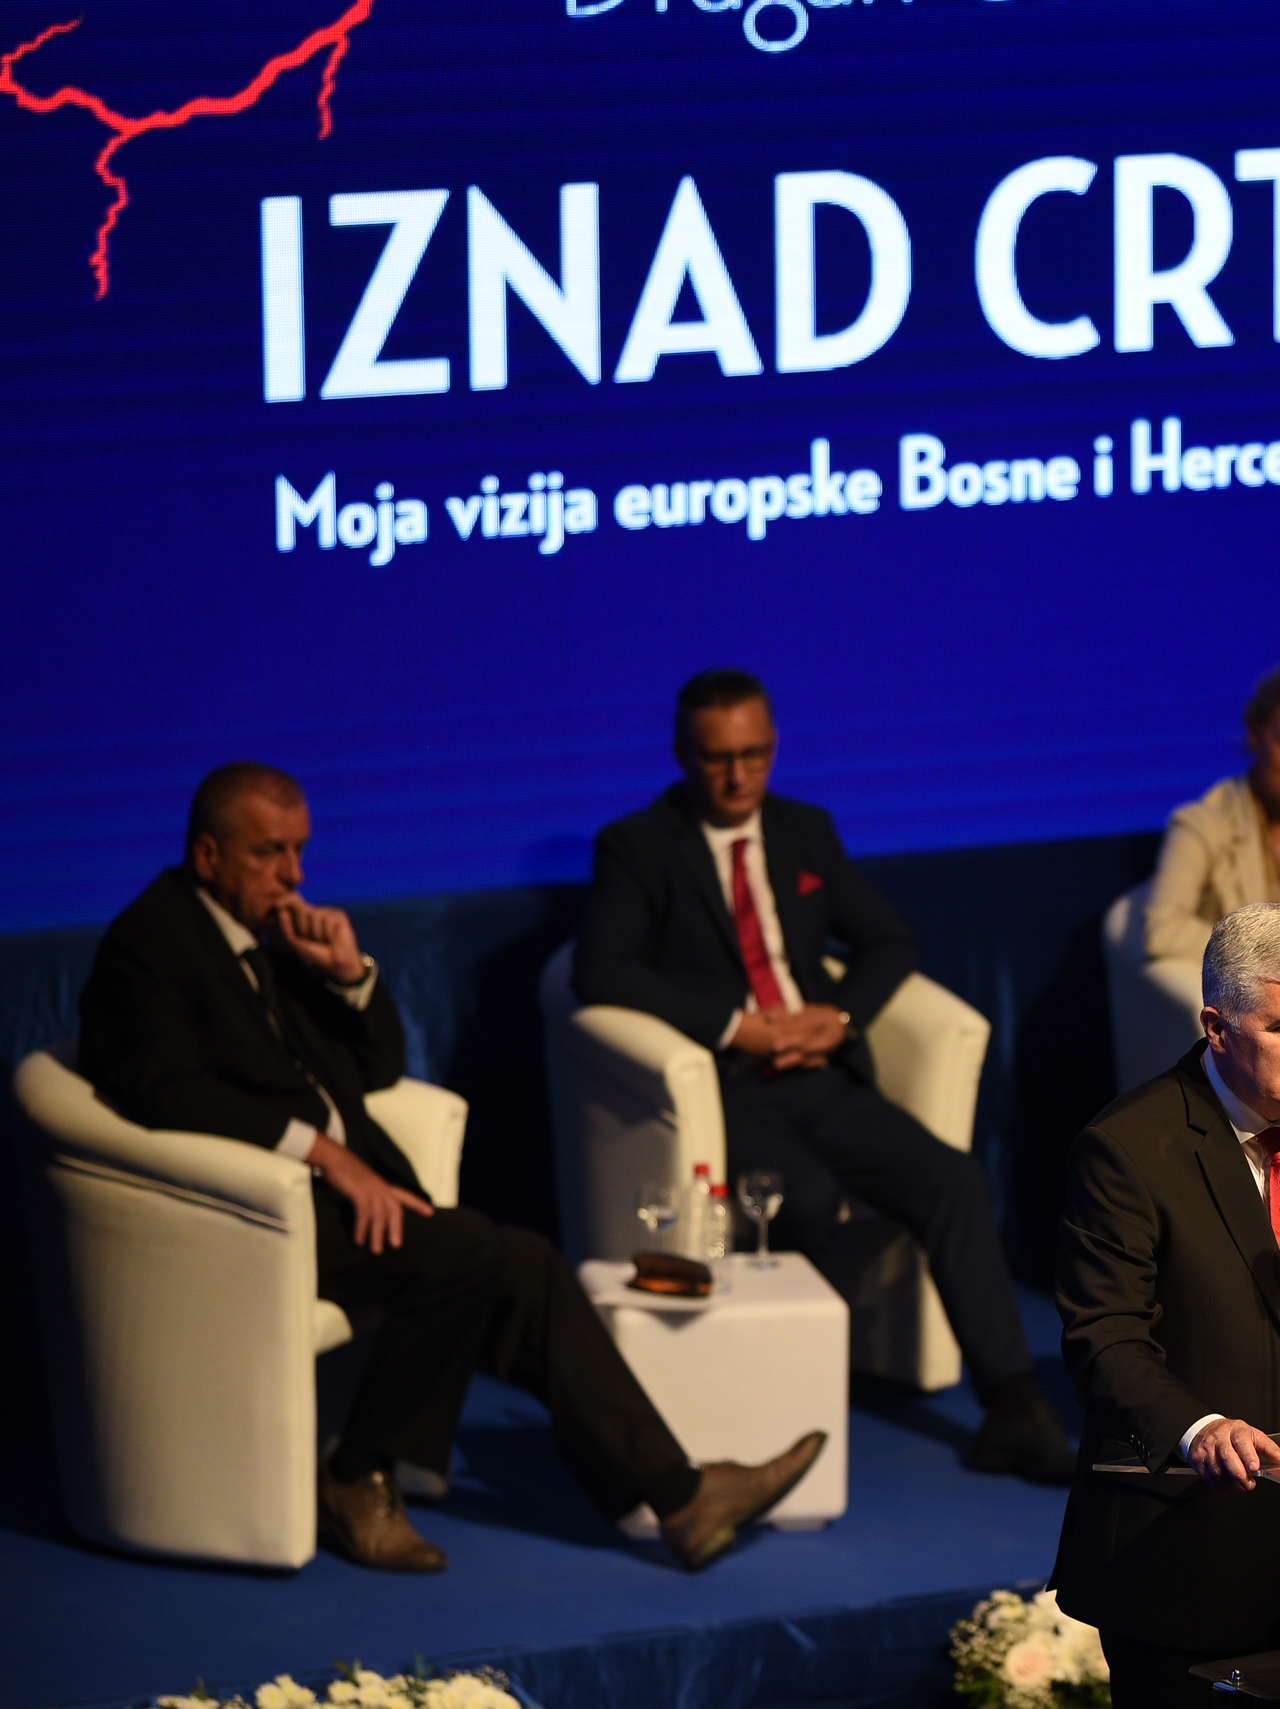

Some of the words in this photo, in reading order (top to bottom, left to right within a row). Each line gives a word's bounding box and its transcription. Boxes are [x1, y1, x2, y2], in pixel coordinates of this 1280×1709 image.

[260, 169, 912, 404] IZNAD
[275, 471, 428, 567] Moja
[445, 471, 599, 555] vizija
[613, 436, 883, 541] europske
[899, 432, 1082, 511] Bosne
[1093, 435, 1114, 498] i
